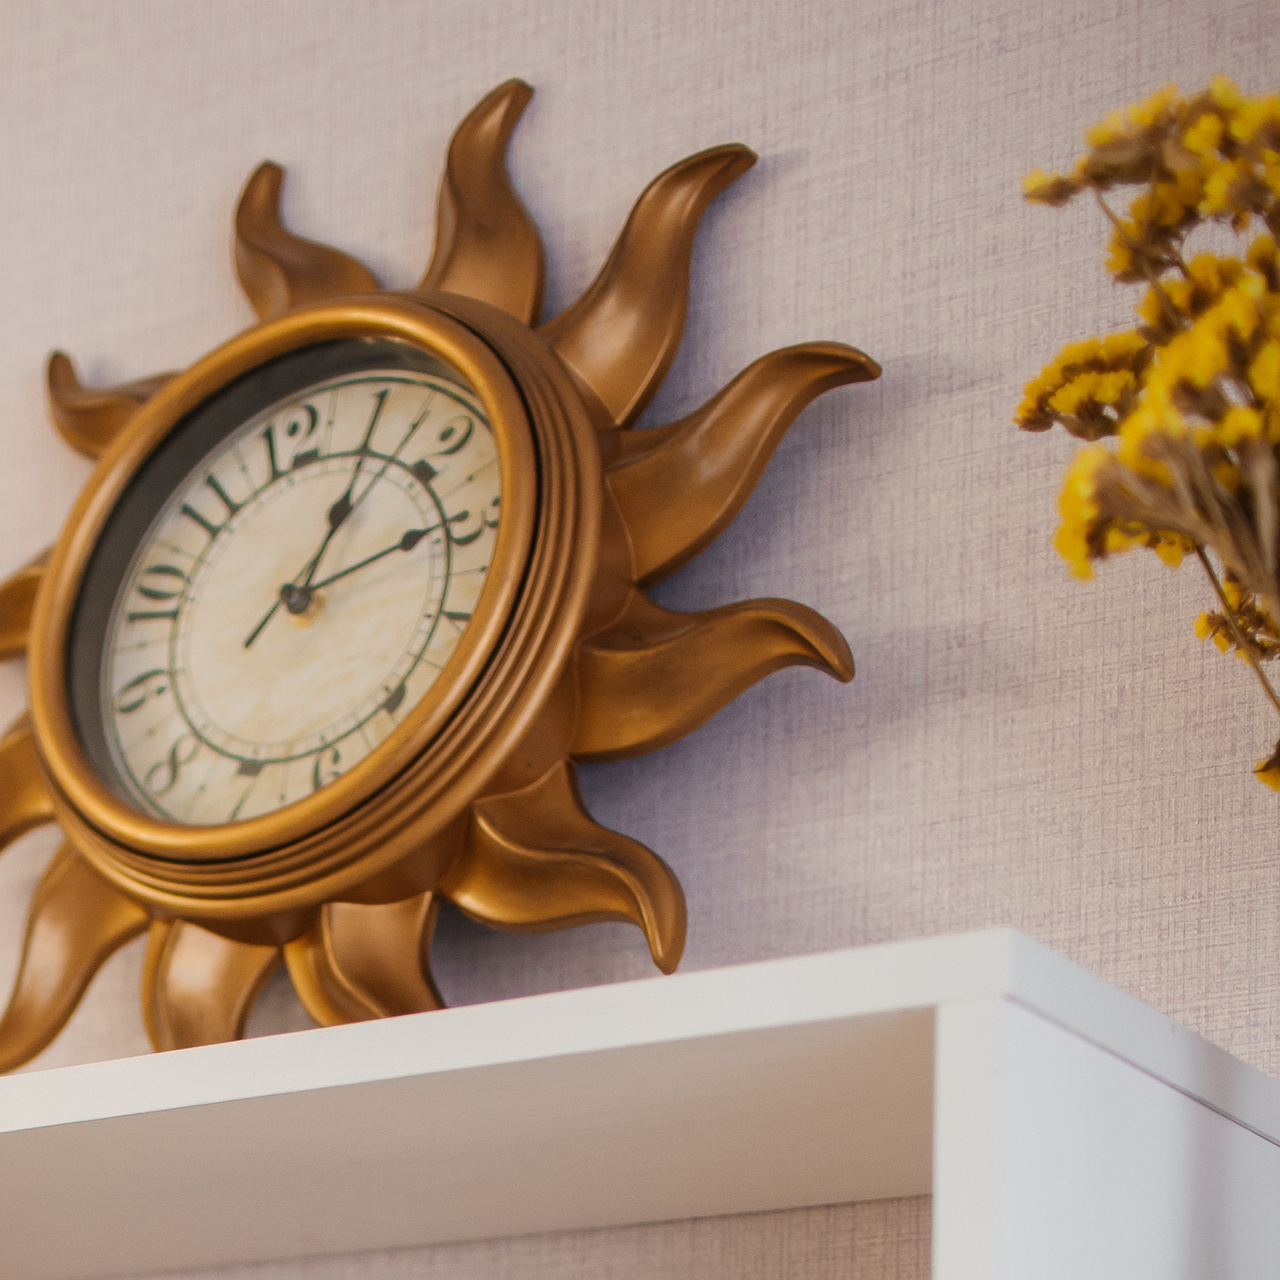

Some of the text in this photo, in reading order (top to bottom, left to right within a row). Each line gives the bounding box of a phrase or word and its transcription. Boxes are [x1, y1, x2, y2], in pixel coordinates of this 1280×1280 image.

[262, 403, 320, 483] 12
[358, 387, 392, 454] 1
[409, 414, 474, 484] 2
[180, 473, 246, 541] 11
[128, 563, 191, 621] 10
[116, 667, 169, 714] 9
[144, 732, 201, 797] 8
